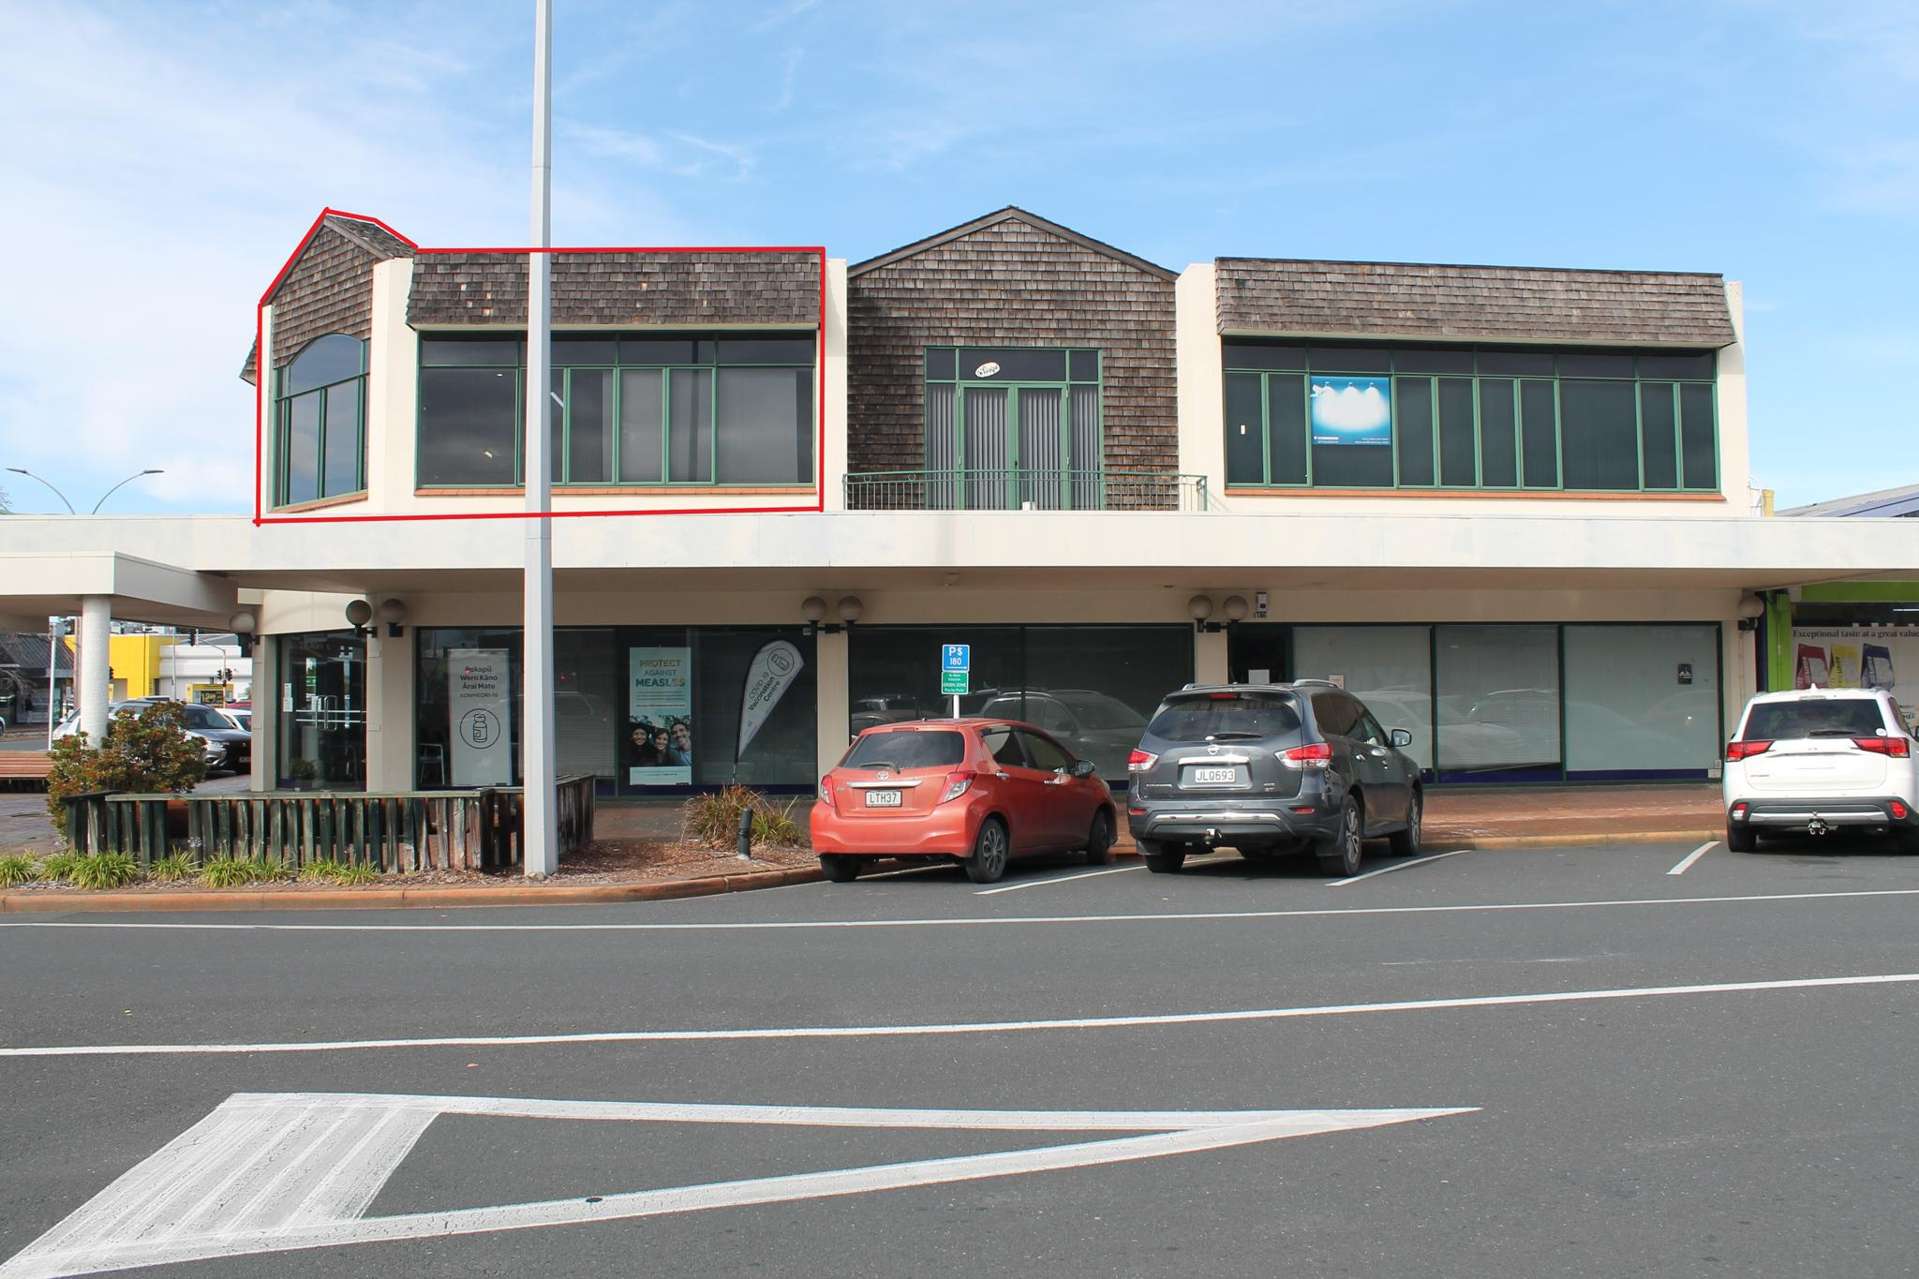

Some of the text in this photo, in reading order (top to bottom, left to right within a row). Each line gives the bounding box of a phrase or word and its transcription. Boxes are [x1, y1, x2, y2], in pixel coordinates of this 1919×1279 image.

[1792, 629, 1839, 640] Exceptional
[1877, 631, 1897, 639] great
[640, 659, 681, 667] PROTECT
[949, 657, 962, 666] 180
[635, 678, 686, 687] MEASLES
[869, 792, 897, 804] LTH37
